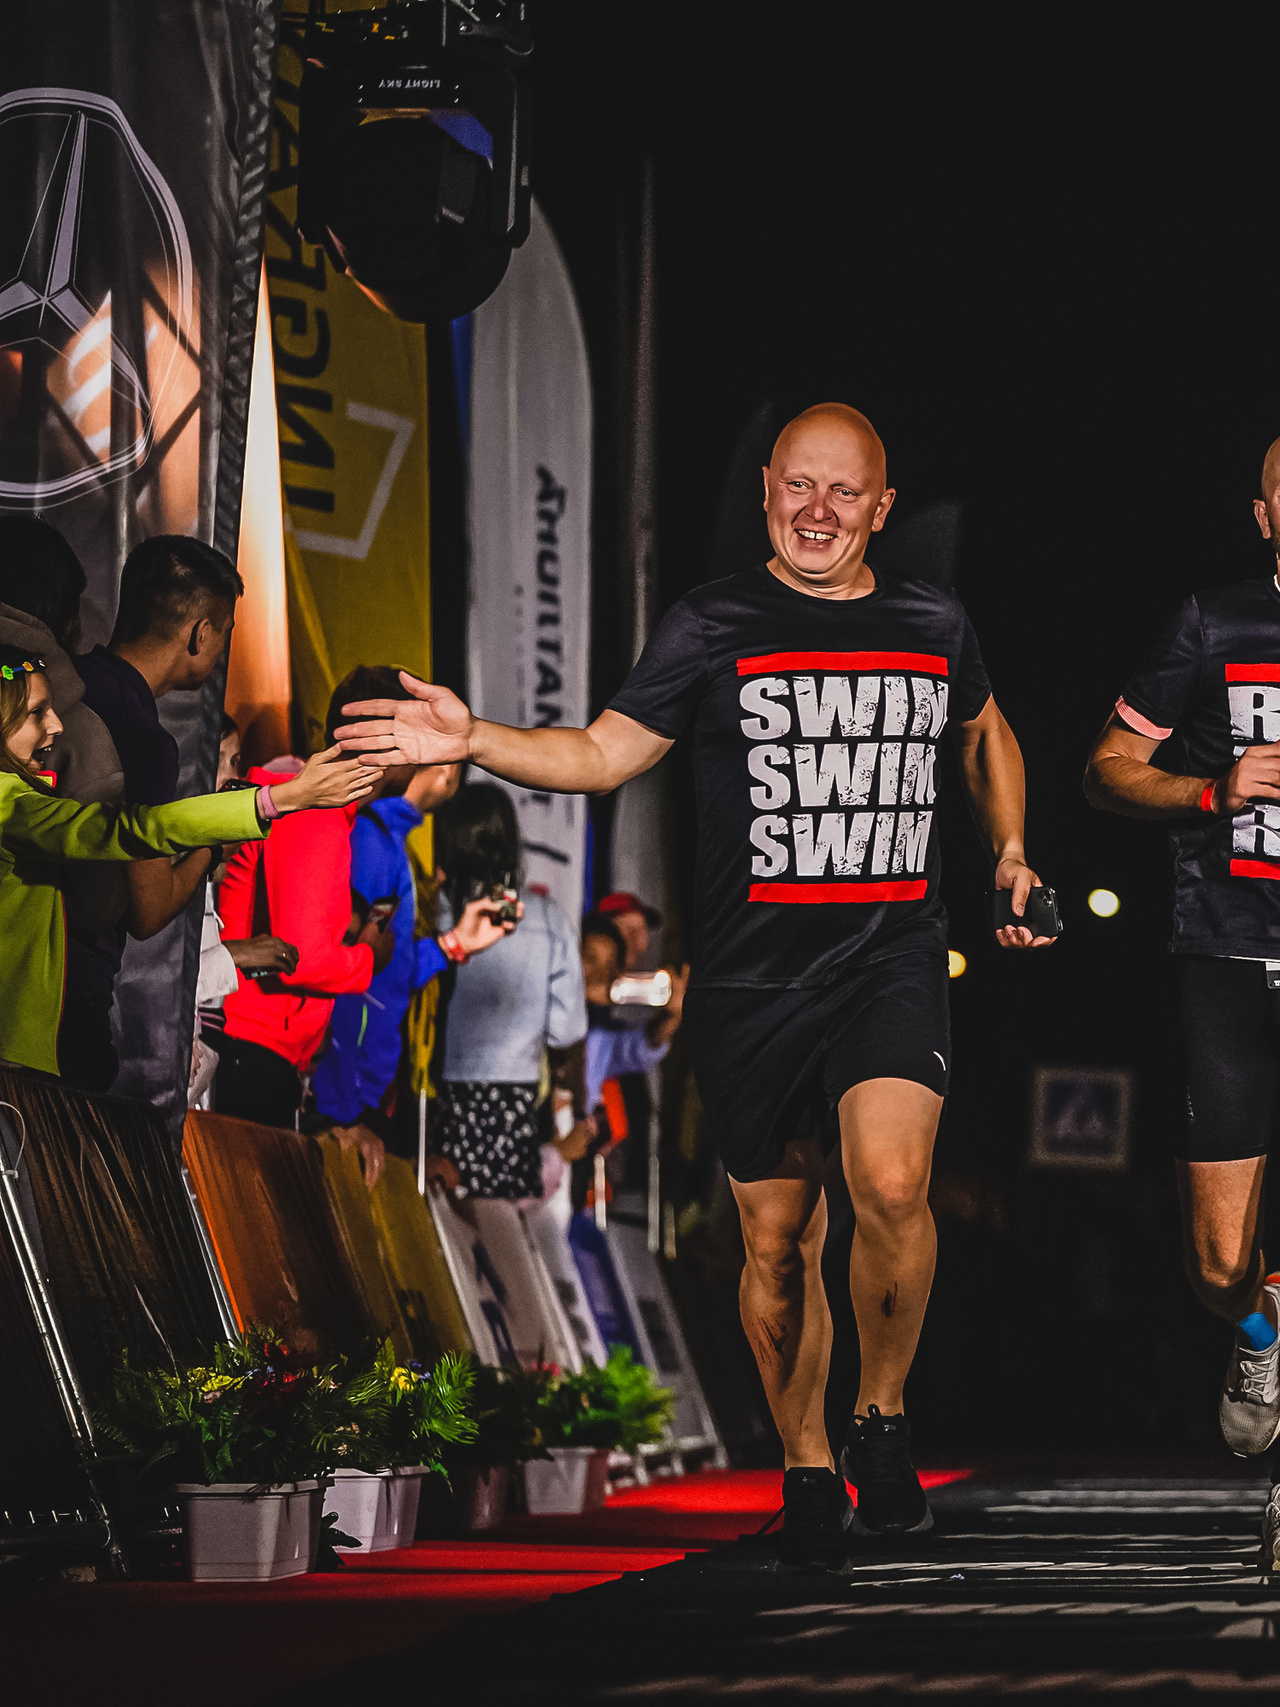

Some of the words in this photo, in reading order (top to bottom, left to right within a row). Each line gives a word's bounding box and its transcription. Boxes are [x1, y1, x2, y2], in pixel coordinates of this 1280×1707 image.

[378, 79, 403, 88] SKY
[404, 79, 441, 88] LIGHT
[748, 742, 937, 810] SWIM
[749, 811, 933, 878] SWIM
